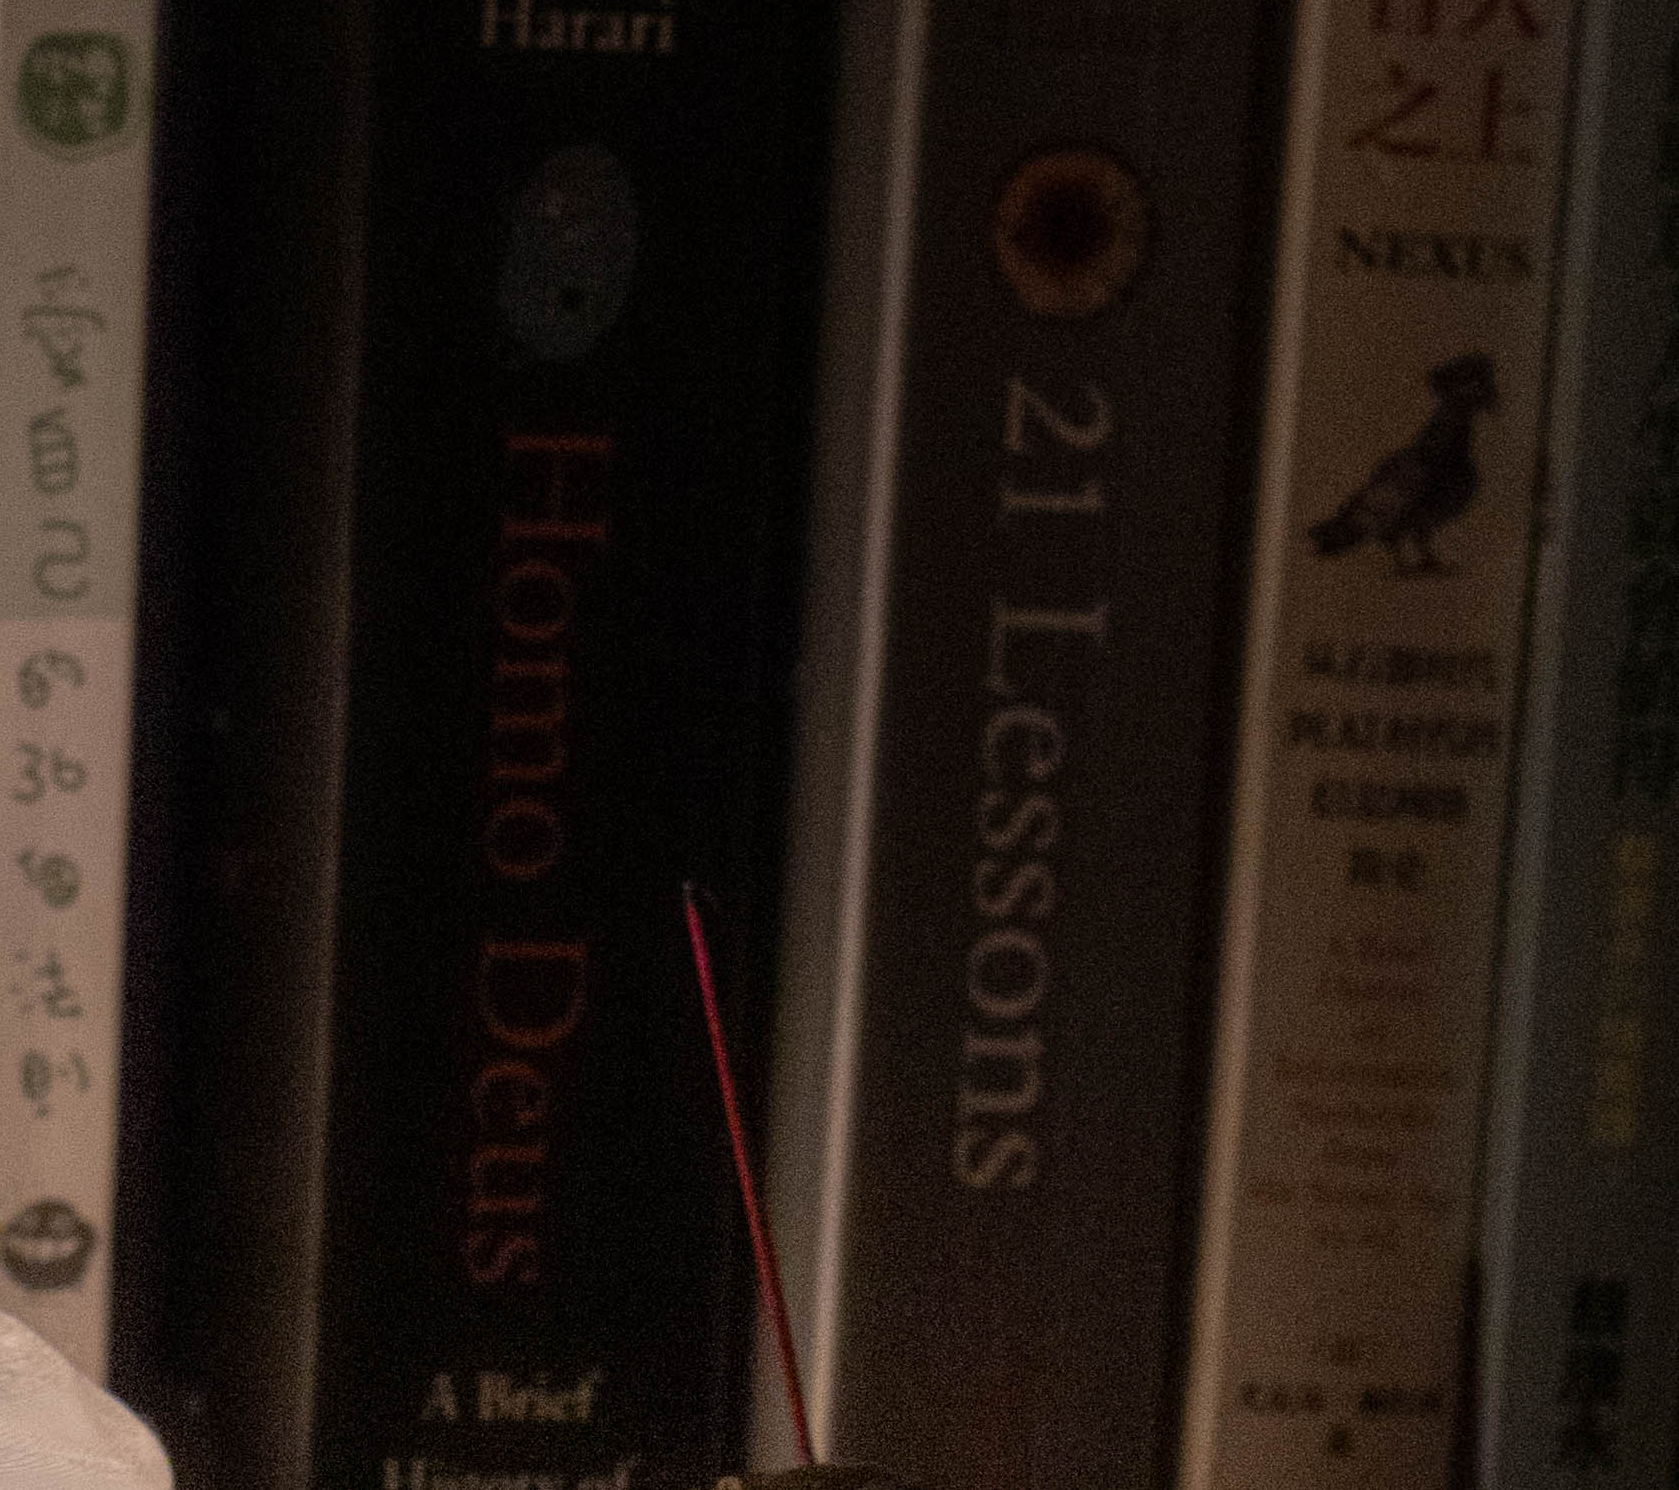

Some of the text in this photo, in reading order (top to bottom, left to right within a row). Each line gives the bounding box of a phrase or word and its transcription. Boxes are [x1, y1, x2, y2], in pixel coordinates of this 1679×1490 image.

[1350, 61, 1531, 162] 之上
[1340, 226, 1535, 284] NEXUS
[953, 375, 1116, 1192] 21 Lessons
[464, 429, 618, 1288] Homo Deus
[421, 1369, 602, 1422] A Brief
